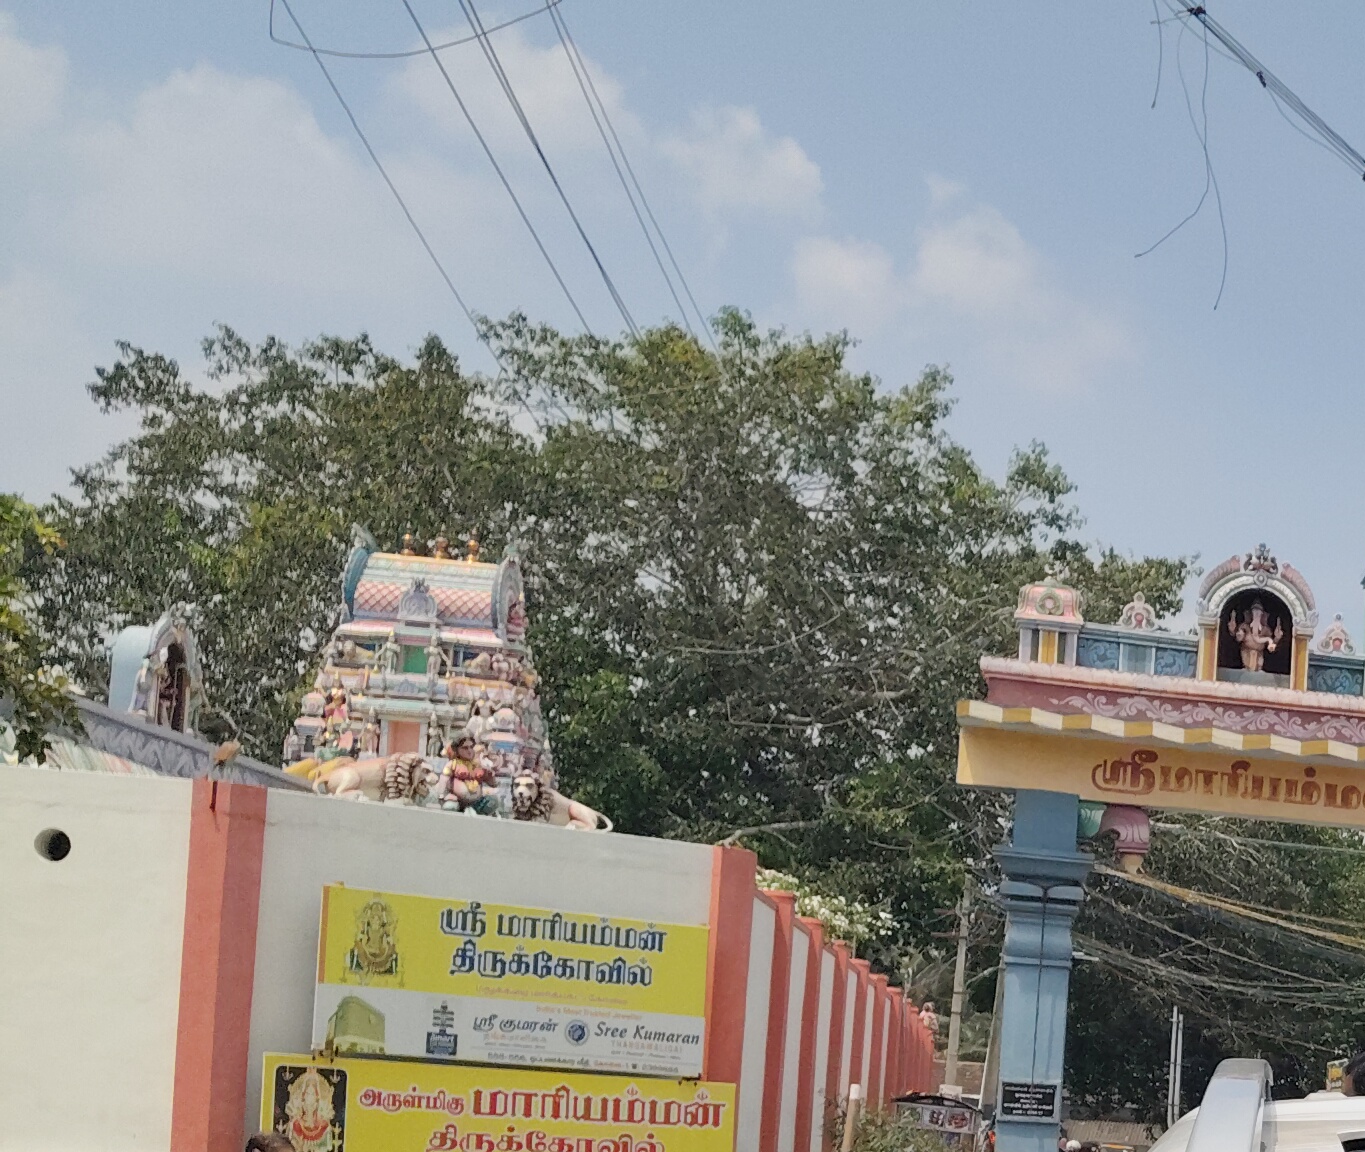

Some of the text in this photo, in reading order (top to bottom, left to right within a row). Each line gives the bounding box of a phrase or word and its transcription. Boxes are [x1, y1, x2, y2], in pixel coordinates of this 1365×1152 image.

[497, 912, 668, 953] மாரியம்மன்
[450, 939, 653, 987] திருக்கோவில்
[594, 1021, 700, 1045] Sree Kumaran
[472, 1084, 726, 1130] மாரியம்மன்
